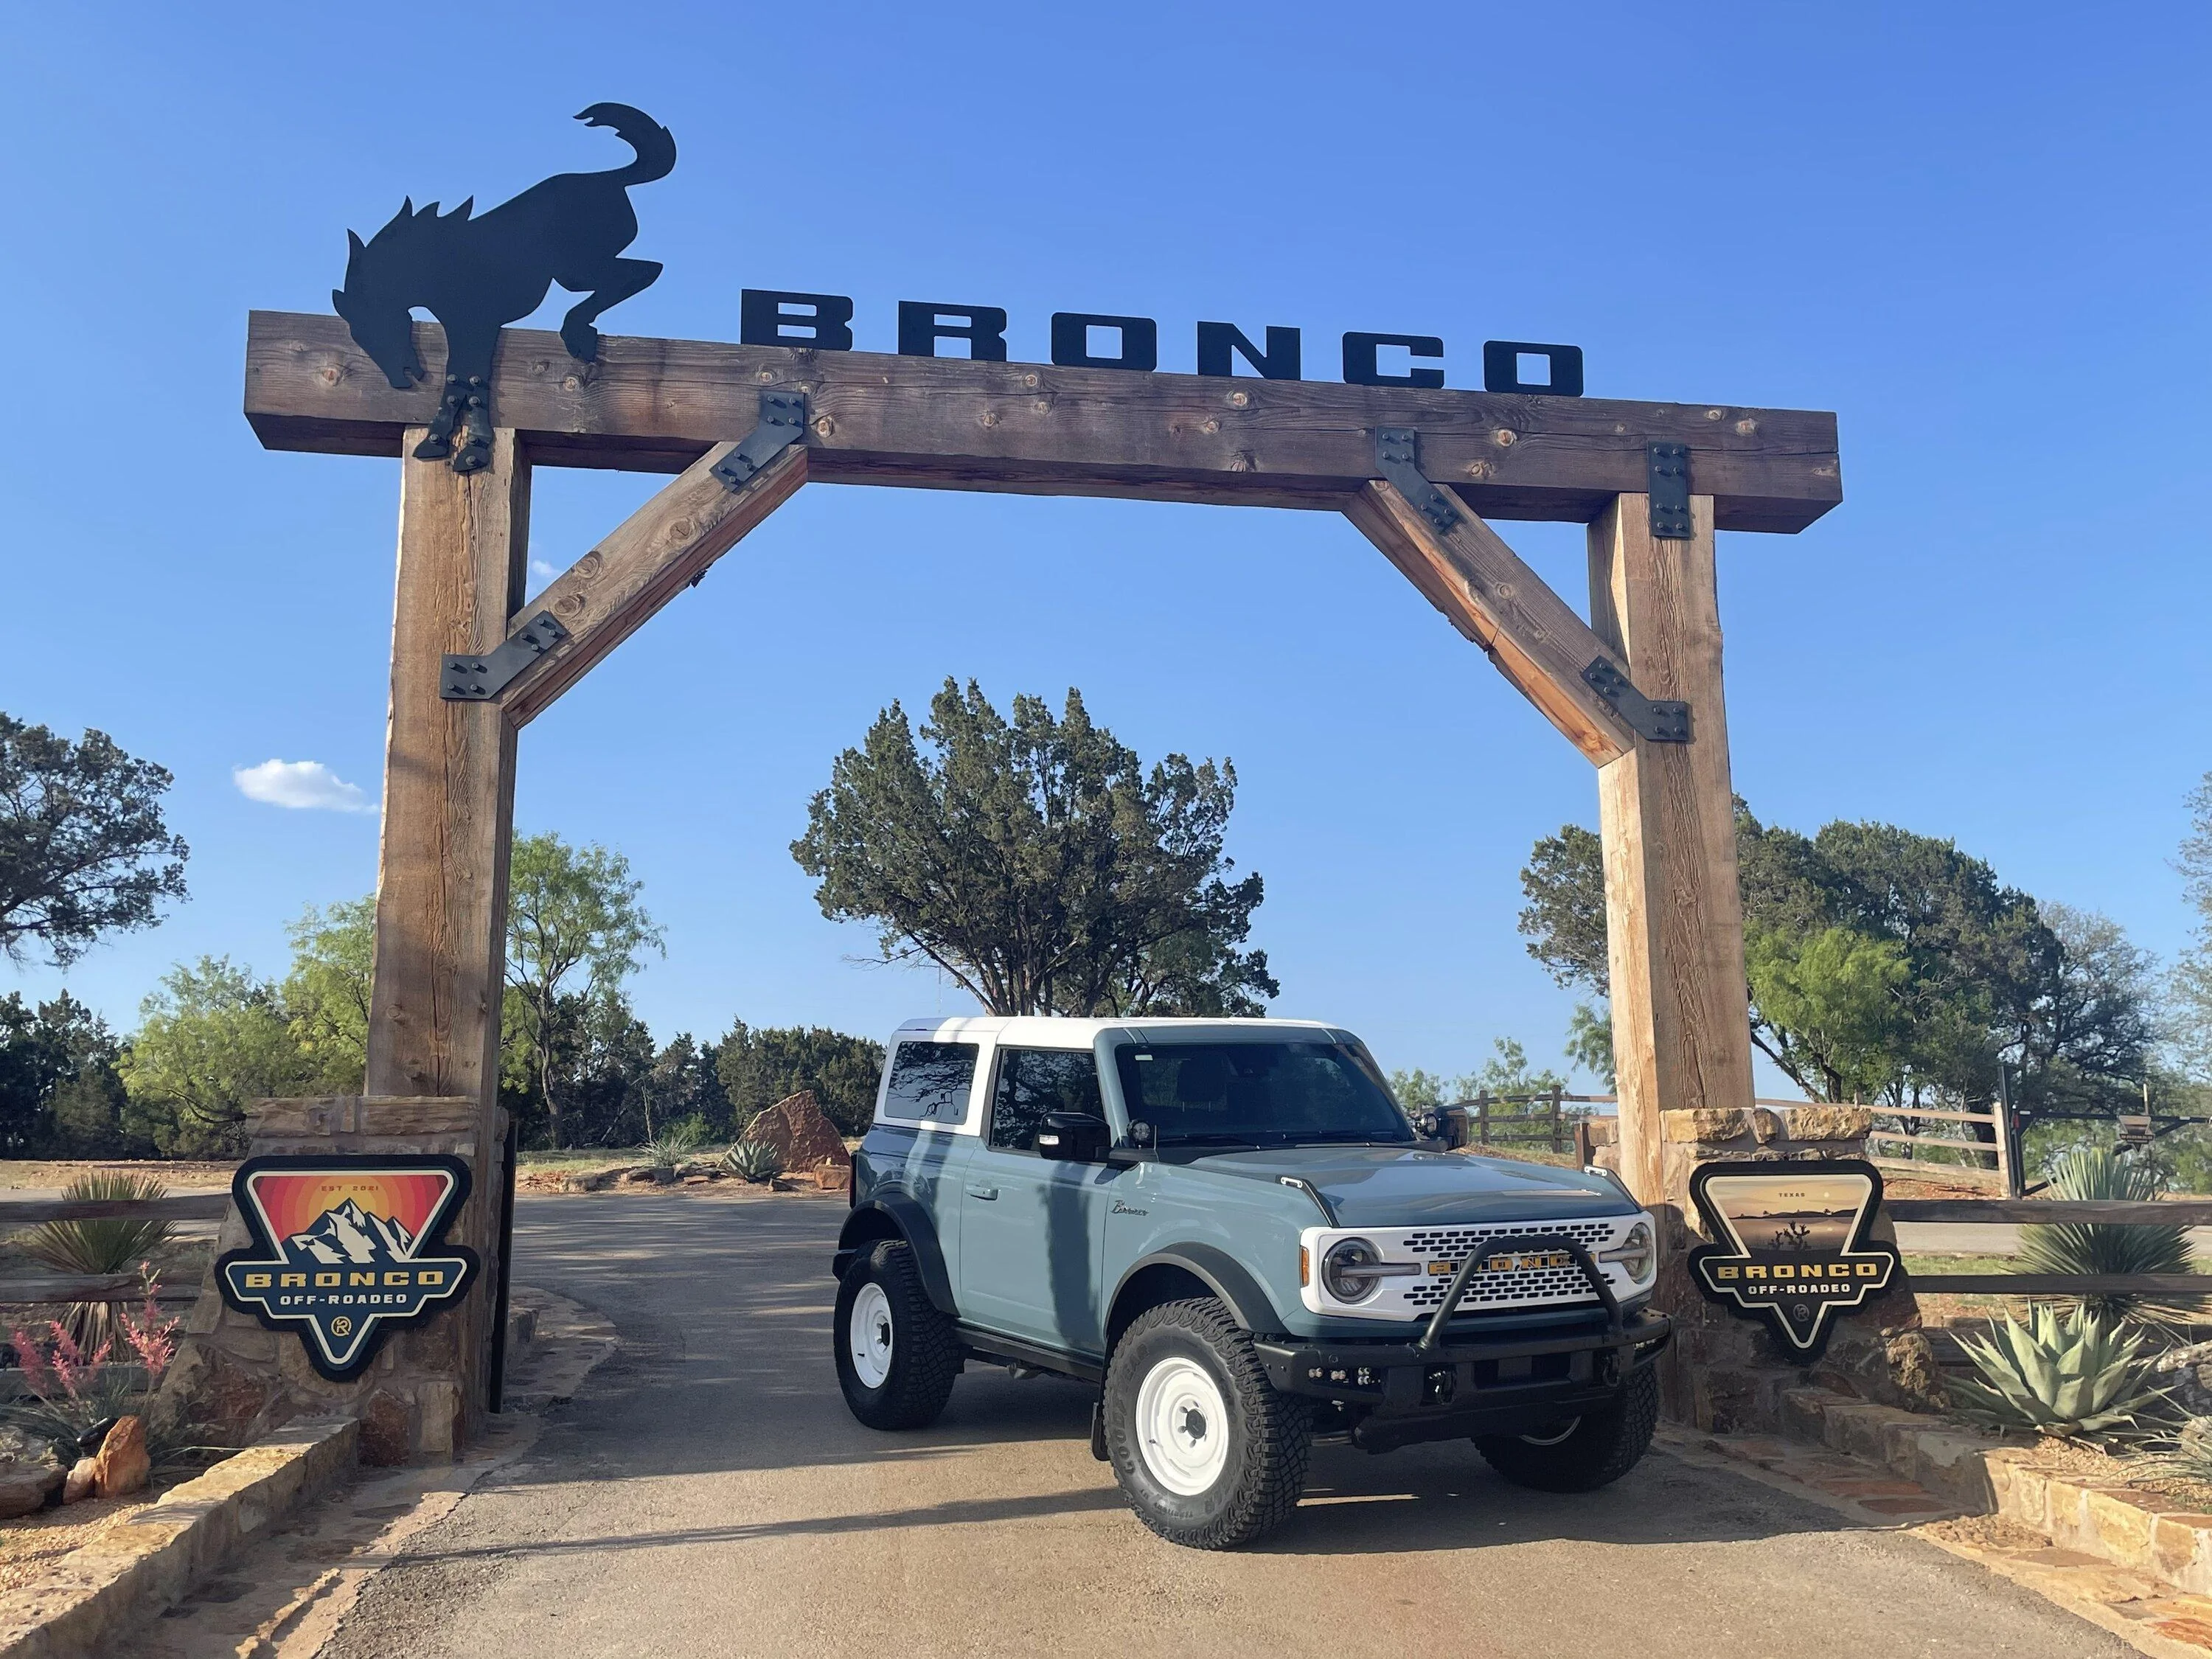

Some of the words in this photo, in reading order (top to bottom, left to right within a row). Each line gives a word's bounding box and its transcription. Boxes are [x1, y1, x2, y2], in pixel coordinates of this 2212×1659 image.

[741, 288, 1584, 397] BRONCO
[245, 1270, 444, 1288] BRONCO
[1717, 1263, 1878, 1280] BRONCO
[1747, 1283, 1851, 1295] OFF-ROADEO
[279, 1293, 407, 1306] OFF-ROADEO
